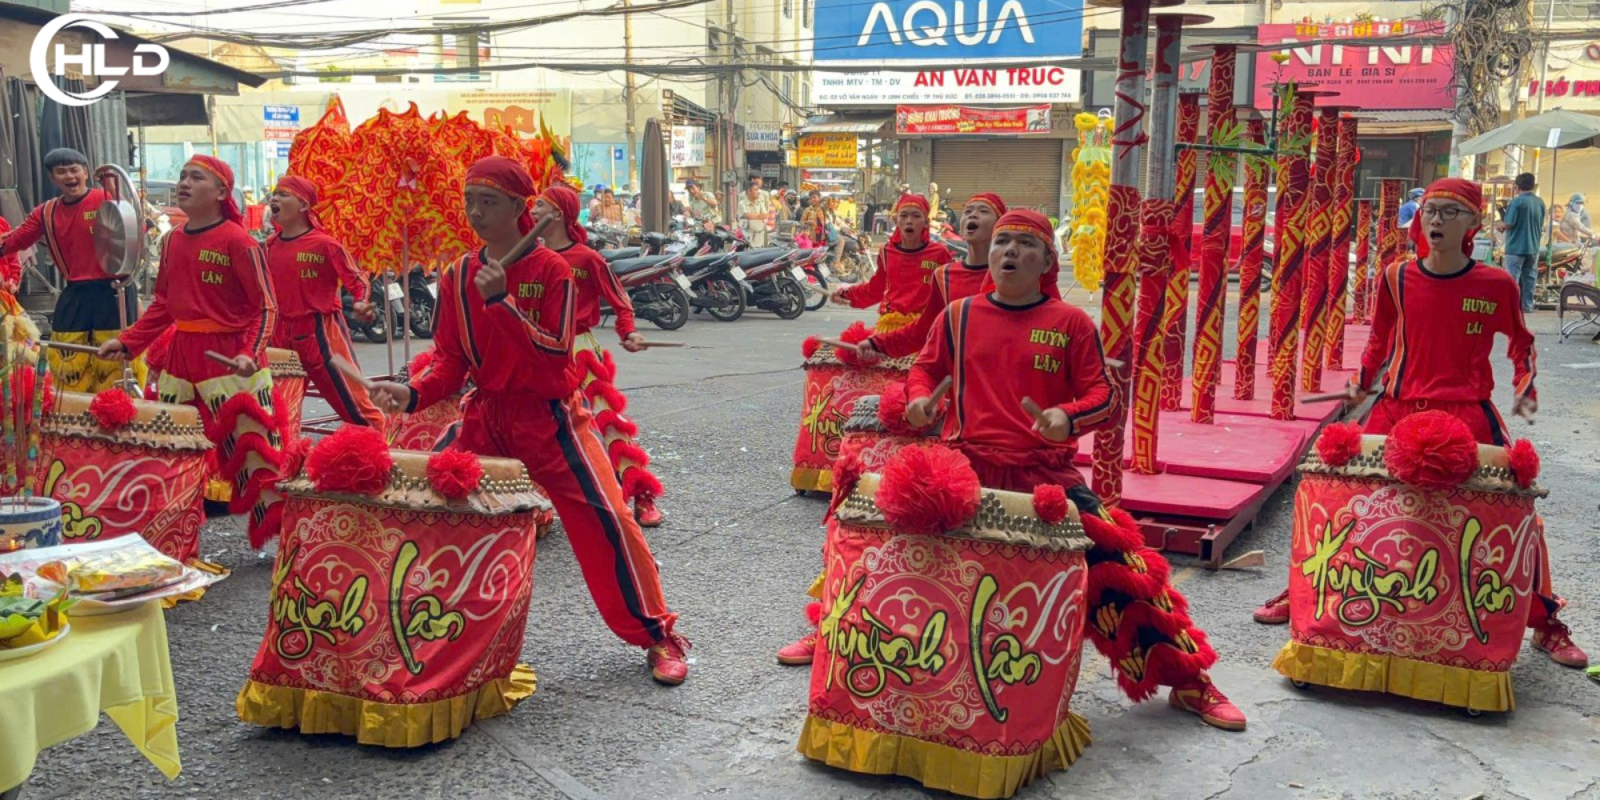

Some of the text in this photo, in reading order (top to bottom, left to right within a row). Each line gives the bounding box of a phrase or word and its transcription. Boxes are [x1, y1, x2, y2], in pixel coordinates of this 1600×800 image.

[857, 0, 1036, 46] AQUA
[1033, 354, 1061, 374] LÂN
[1302, 518, 1440, 627] Huỳnh
[820, 573, 948, 698] Huỳnh
